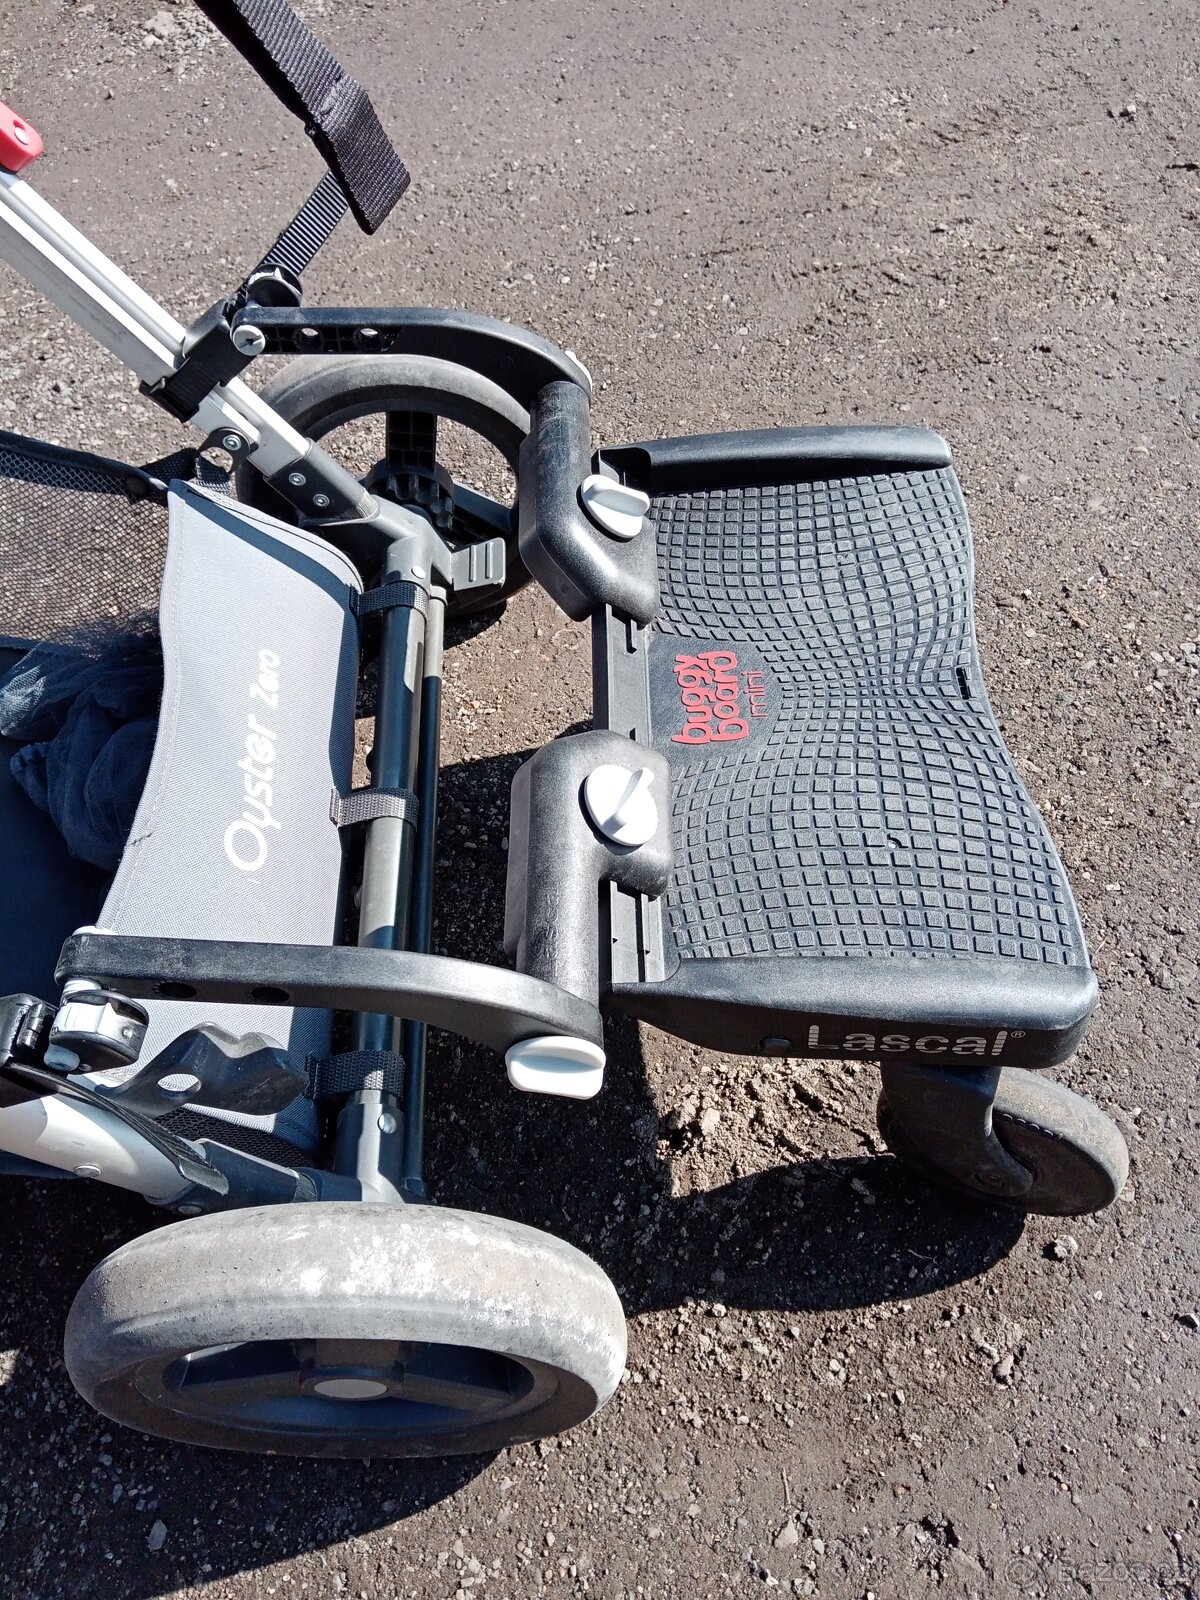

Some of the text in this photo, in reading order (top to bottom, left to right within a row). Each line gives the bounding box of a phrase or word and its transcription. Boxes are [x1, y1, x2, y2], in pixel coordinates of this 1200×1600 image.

[671, 655, 717, 745] buggy
[696, 650, 750, 742] board
[741, 670, 768, 718] mini
[224, 650, 281, 872] Oyster Zero
